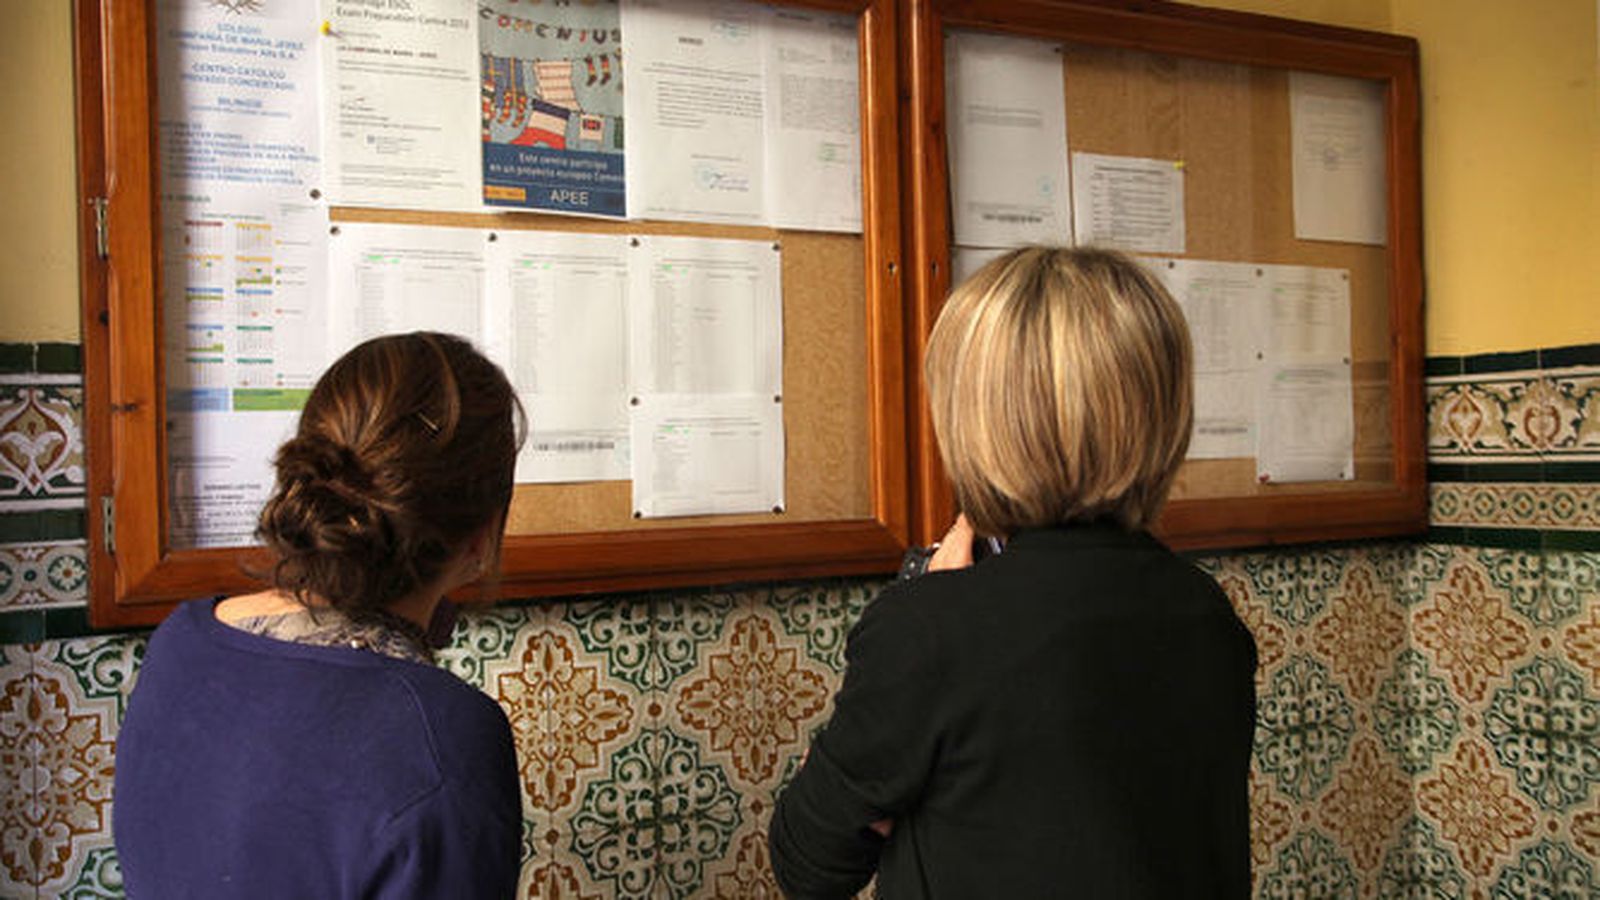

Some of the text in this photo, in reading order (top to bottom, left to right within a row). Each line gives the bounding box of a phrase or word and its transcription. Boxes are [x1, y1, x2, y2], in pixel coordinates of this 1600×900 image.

[364, 9, 415, 22] Preparation
[479, 6, 622, 44] COMENIUS
[192, 63, 236, 74] CENTRO
[519, 153, 538, 163] Este
[540, 156, 567, 166] centro
[550, 189, 589, 206] APEE
